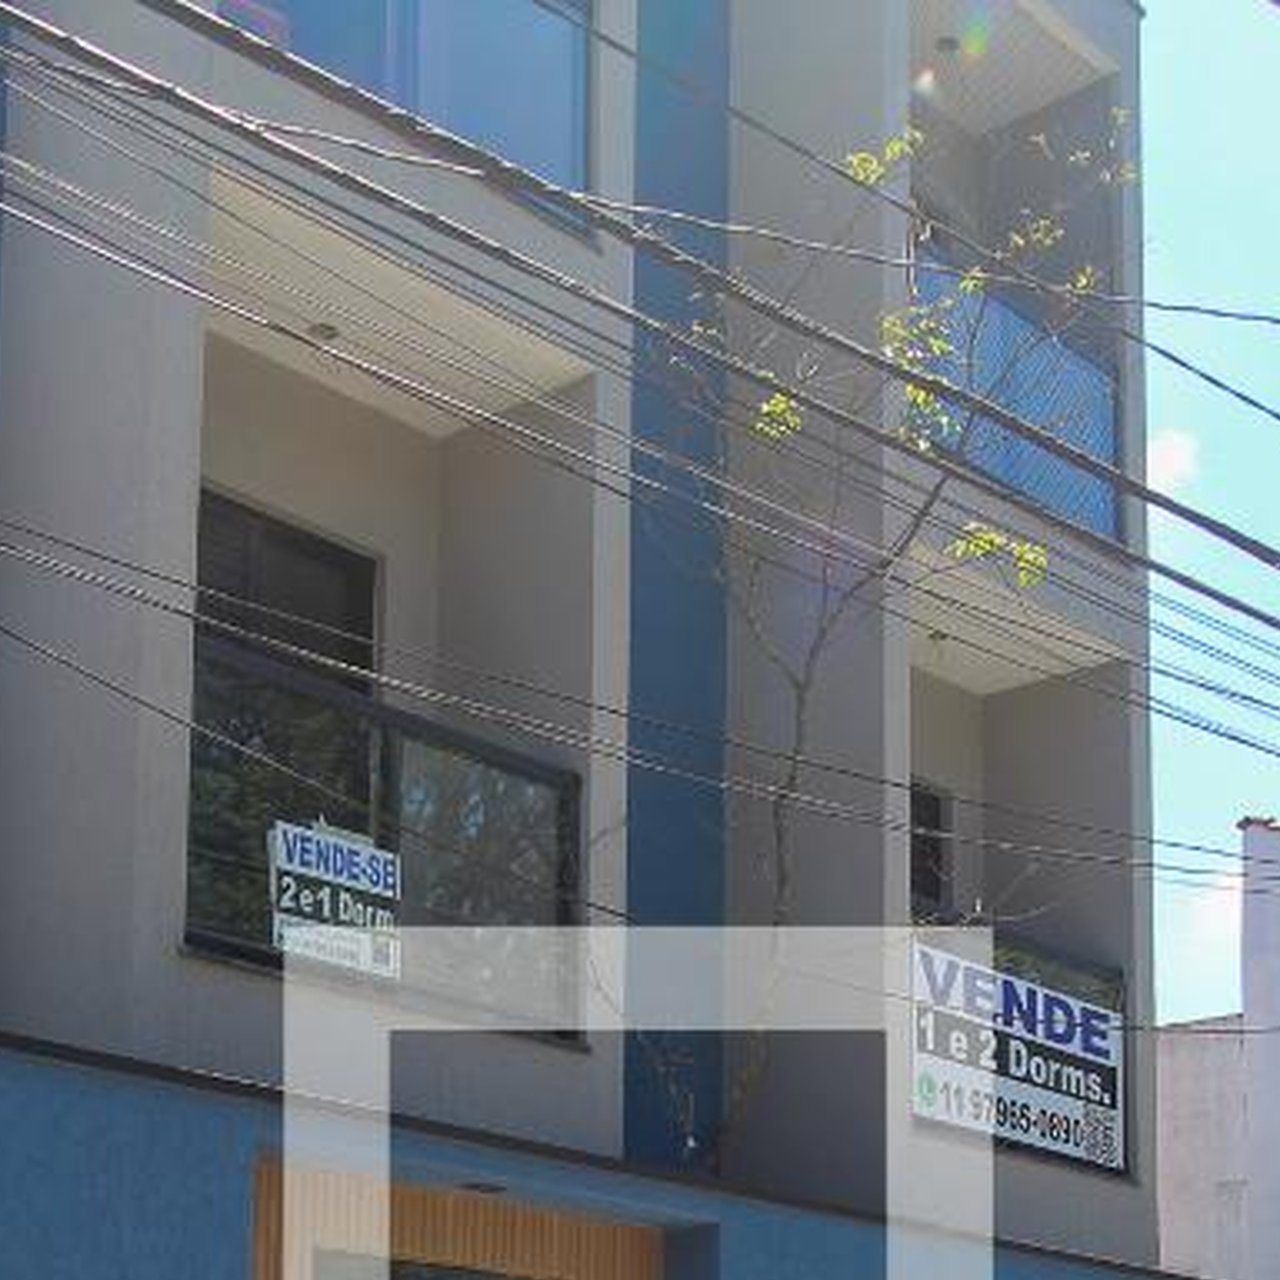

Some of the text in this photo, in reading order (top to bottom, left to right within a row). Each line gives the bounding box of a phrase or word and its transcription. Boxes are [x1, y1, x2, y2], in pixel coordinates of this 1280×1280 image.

[282, 830, 397, 889] VENDE-SE
[918, 949, 1112, 1061] VENDE
[919, 1007, 1112, 1105] 1 e 2 Dorms.
